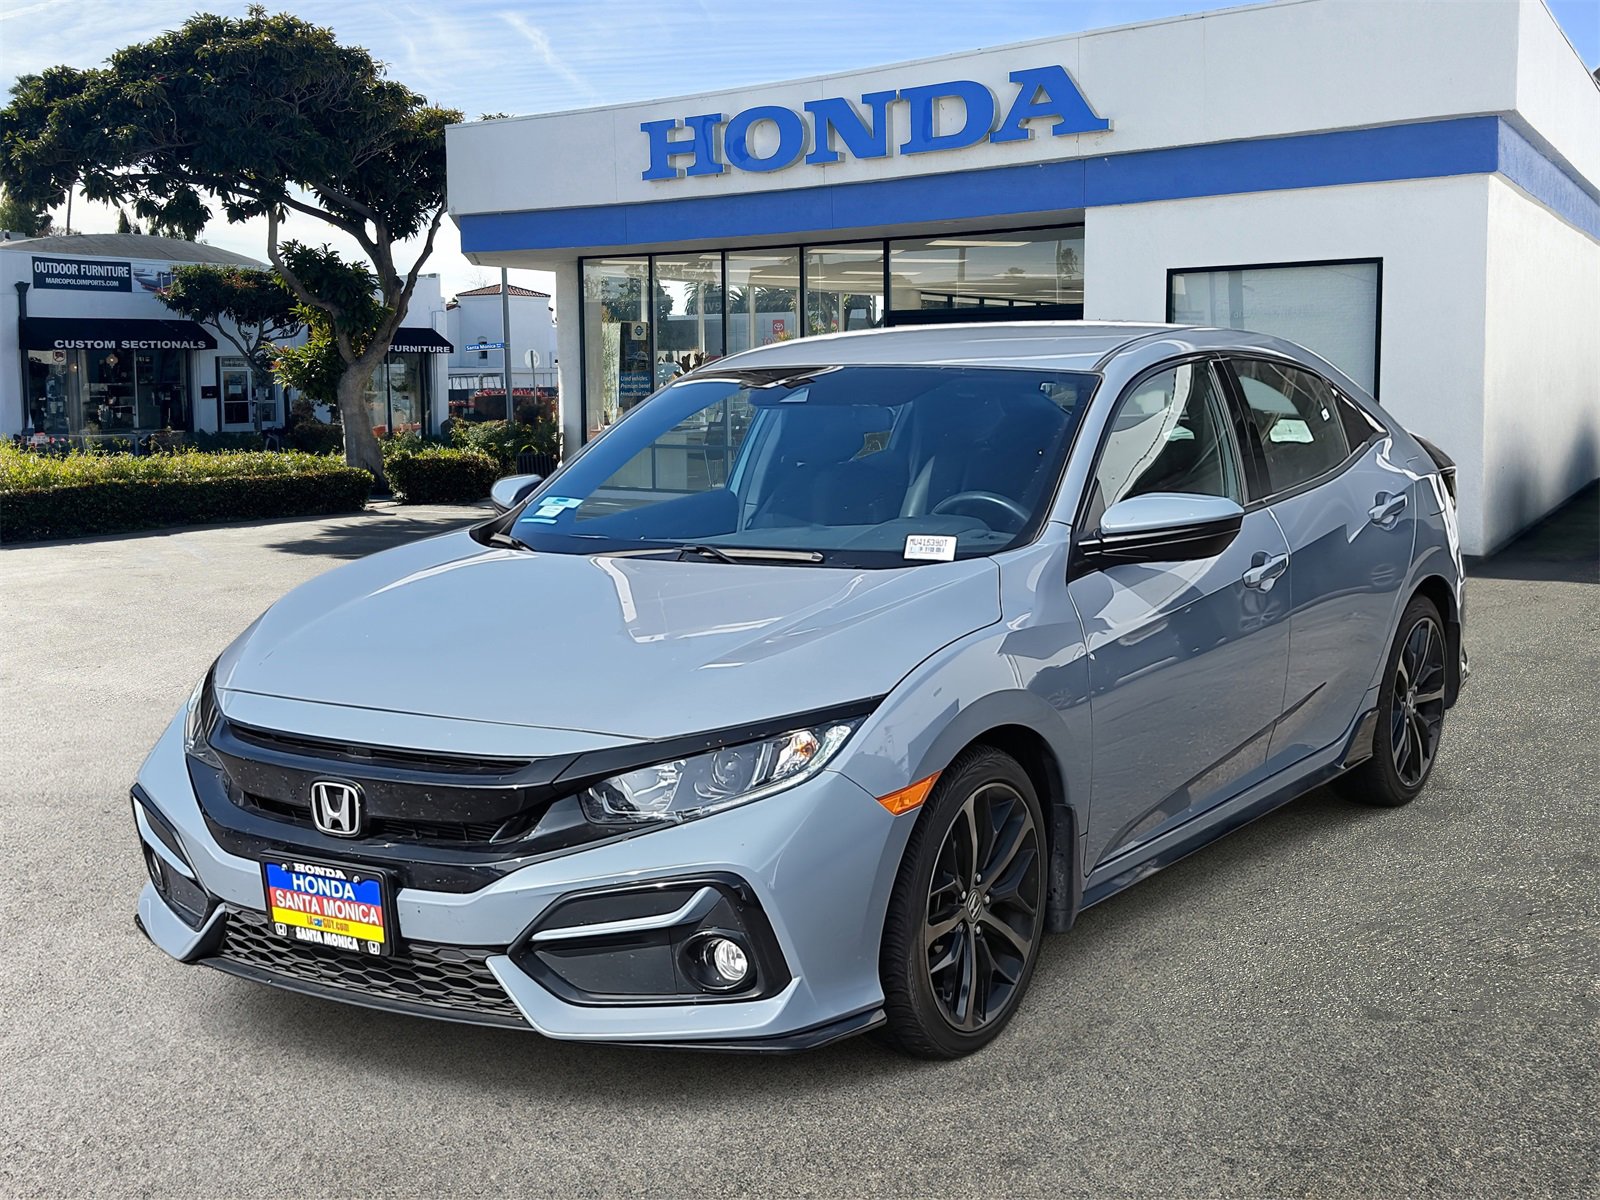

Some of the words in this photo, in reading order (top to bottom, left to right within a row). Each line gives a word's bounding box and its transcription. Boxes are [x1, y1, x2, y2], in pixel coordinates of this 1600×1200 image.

[640, 65, 1114, 182] HONDA
[34, 261, 79, 275] OUTDOOR
[80, 264, 130, 278] FURNITURE
[45, 277, 119, 287] MARCOPOLOIMPORTS.COM
[53, 339, 116, 349] CUSTOM
[121, 340, 206, 349] SECTIONALS
[387, 344, 451, 353] FURNITURE
[293, 862, 347, 880] HONDA
[291, 873, 356, 900] HONDA
[275, 889, 322, 915] SANTA
[323, 898, 380, 925] MONICA
[295, 926, 323, 944] SANTA
[324, 930, 360, 951] MONICA
